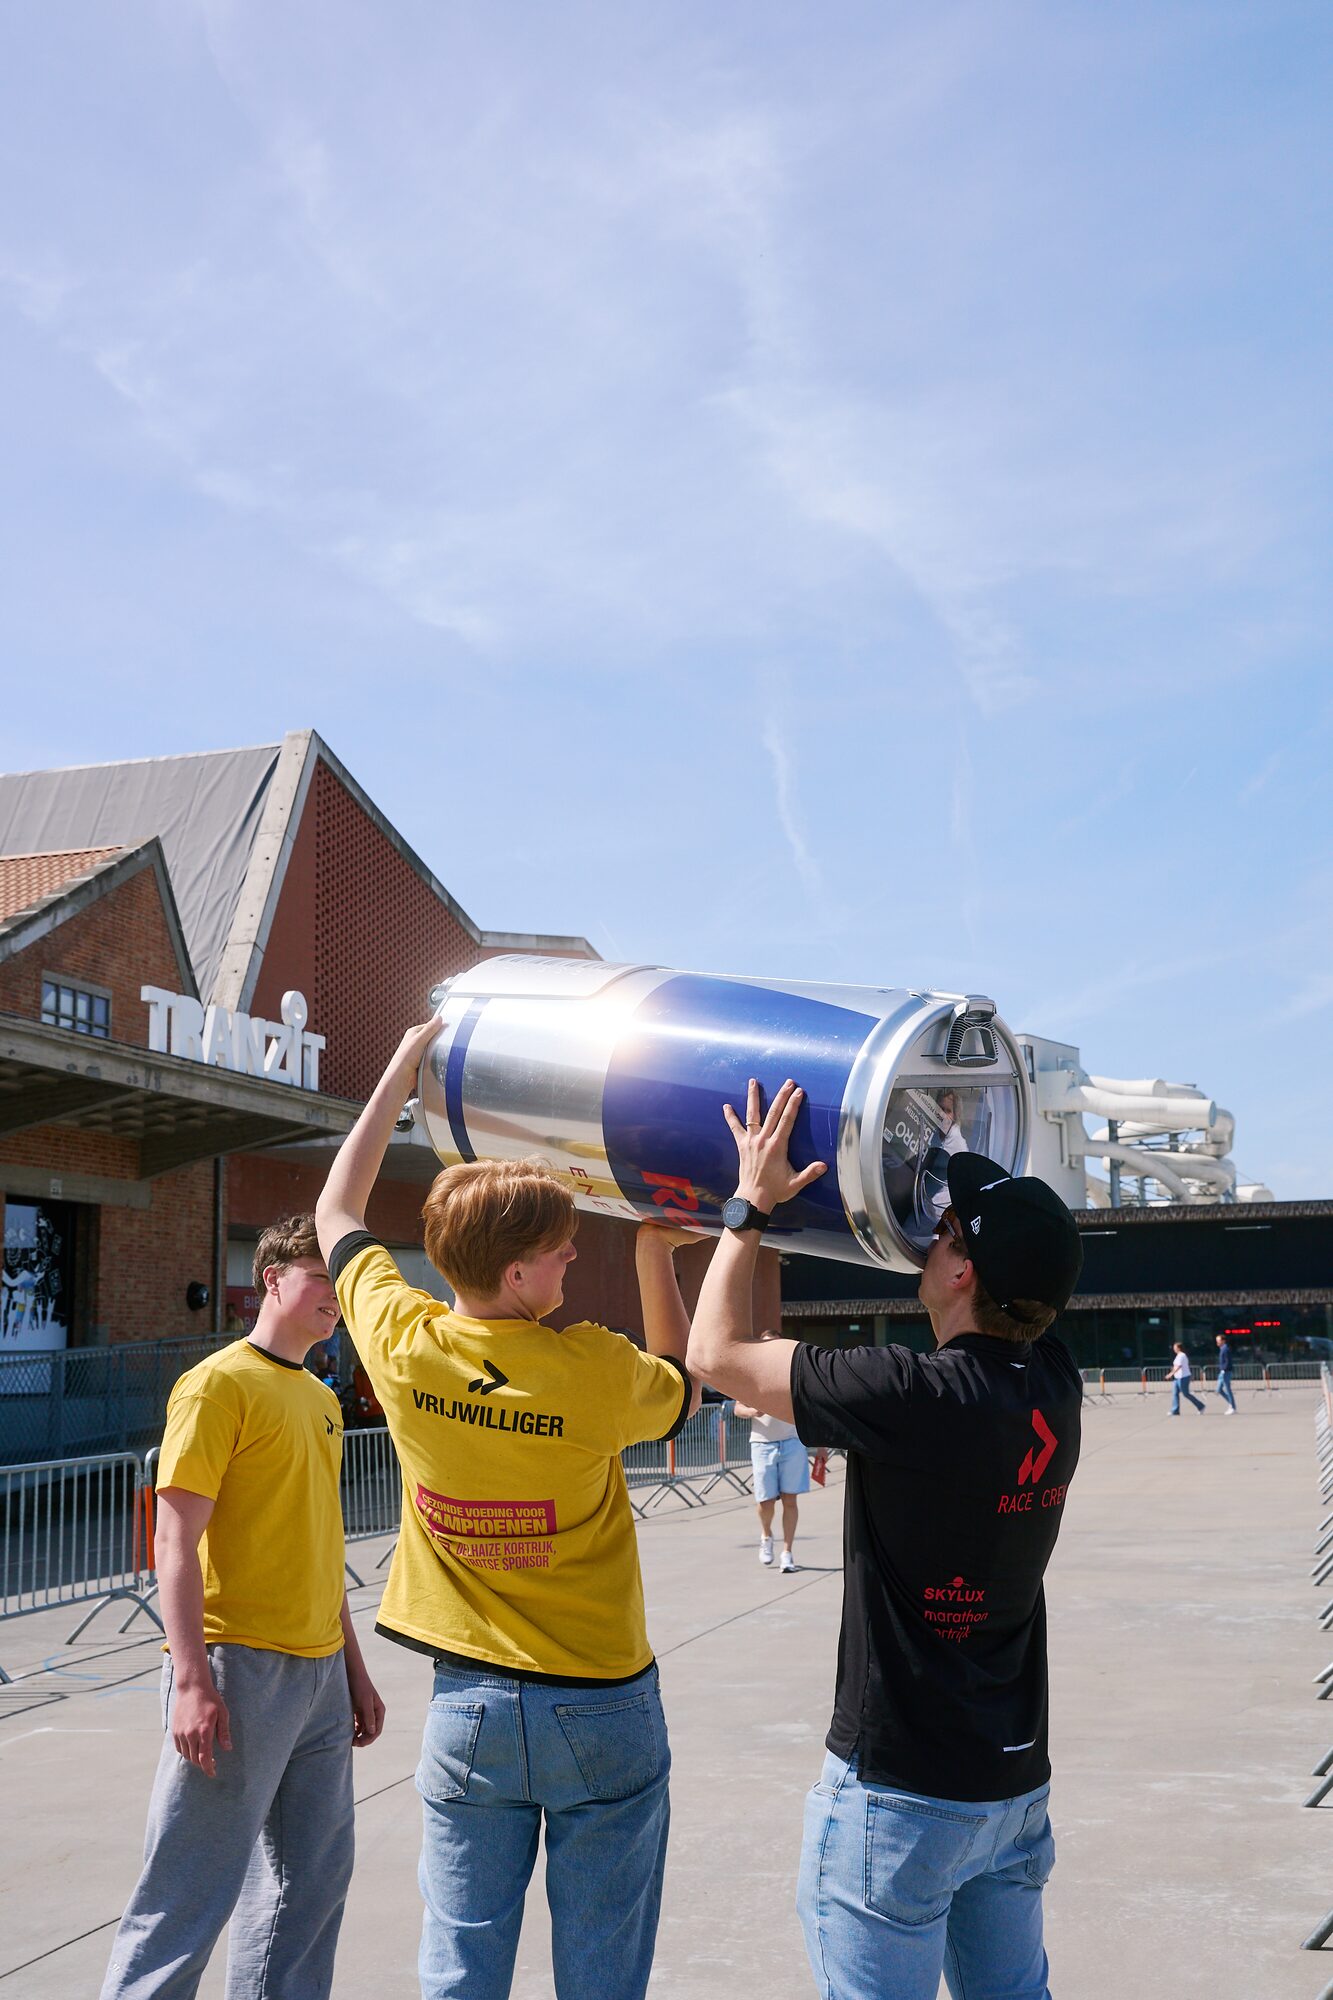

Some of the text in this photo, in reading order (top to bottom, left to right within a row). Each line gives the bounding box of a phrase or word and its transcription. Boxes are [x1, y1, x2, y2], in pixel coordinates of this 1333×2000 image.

[412, 1389, 564, 1437] VRIJWILLIGER
[422, 1494, 546, 1518] GEZONDE VOEDING VOOR
[997, 1492, 1034, 1513] RACE
[456, 1541, 557, 1557] DELHAIZE KORTRIJK,
[465, 1556, 549, 1571] TROTSE SPONSOR
[924, 1587, 985, 1602] SKYLUX
[924, 1609, 988, 1623] marathon
[934, 1625, 971, 1643] rtrijk
